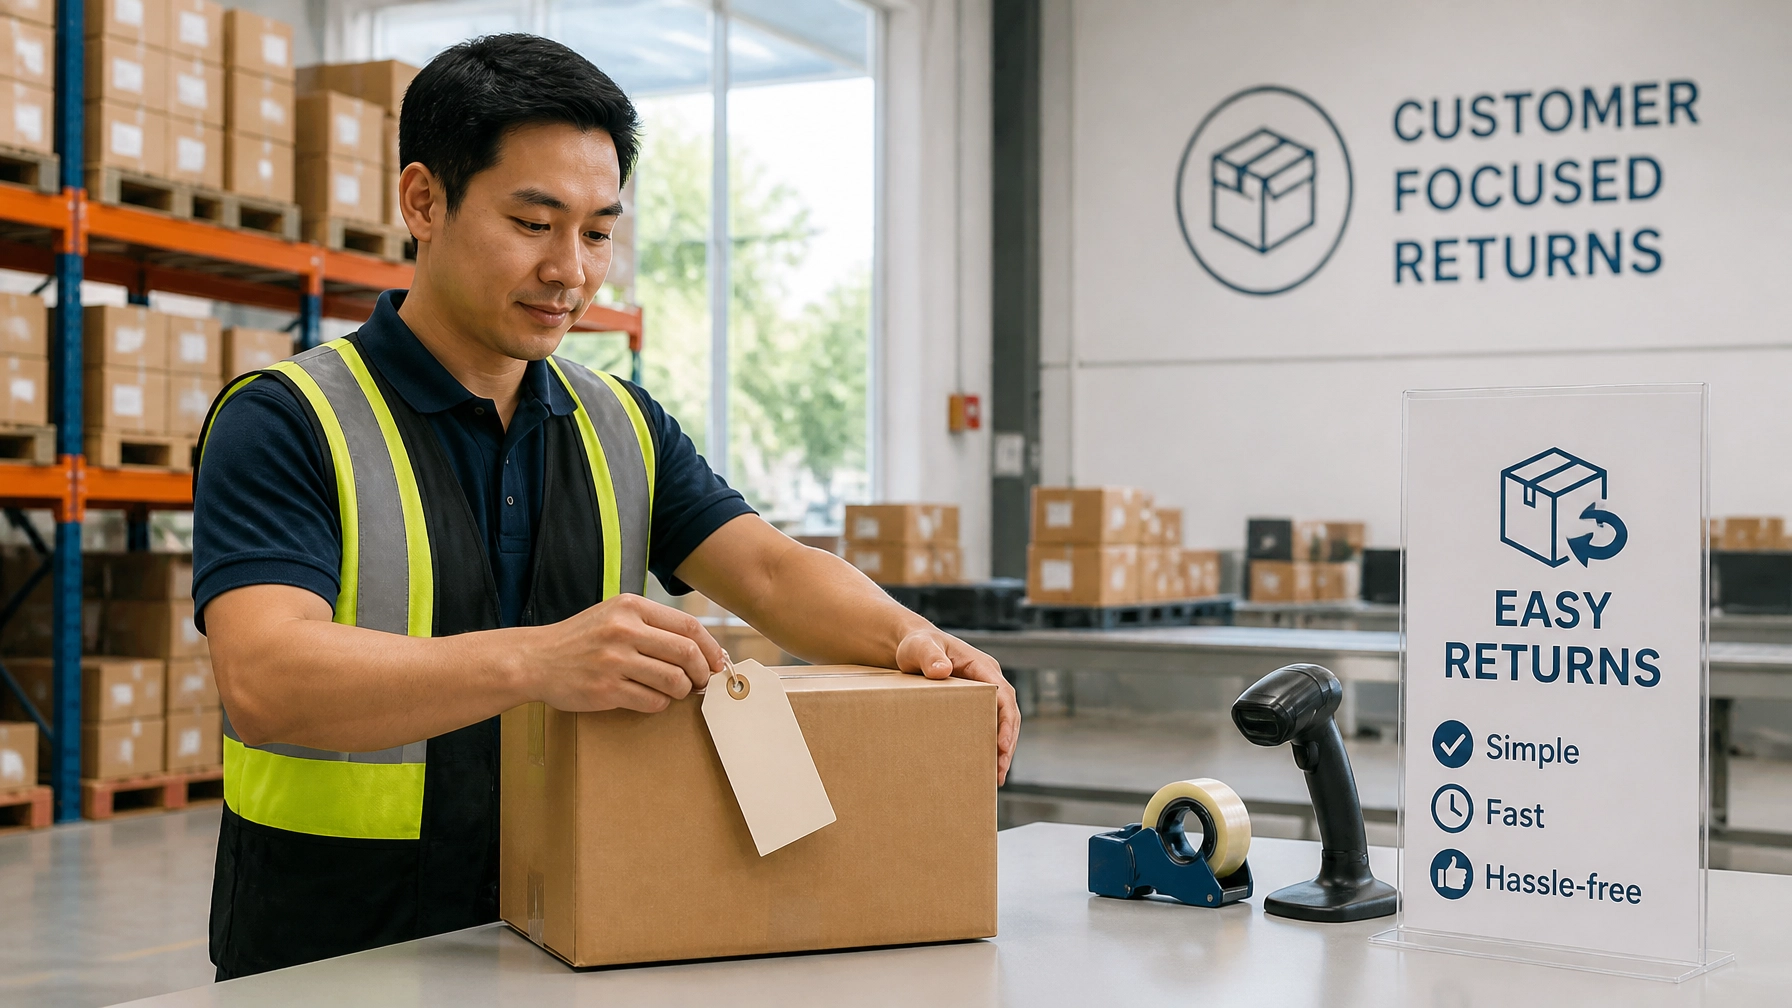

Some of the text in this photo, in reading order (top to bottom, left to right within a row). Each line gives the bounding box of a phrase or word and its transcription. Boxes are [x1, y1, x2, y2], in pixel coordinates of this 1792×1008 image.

[1393, 79, 1700, 143] CUSTOMER
[1394, 155, 1663, 213] FOCUSED
[1394, 228, 1663, 284] RETURNS
[1495, 589, 1613, 630] EASY
[1445, 641, 1662, 688] RETURNS
[1486, 733, 1580, 770] Simple
[1486, 798, 1546, 829] Fast
[1486, 863, 1642, 905] Hassle-free
